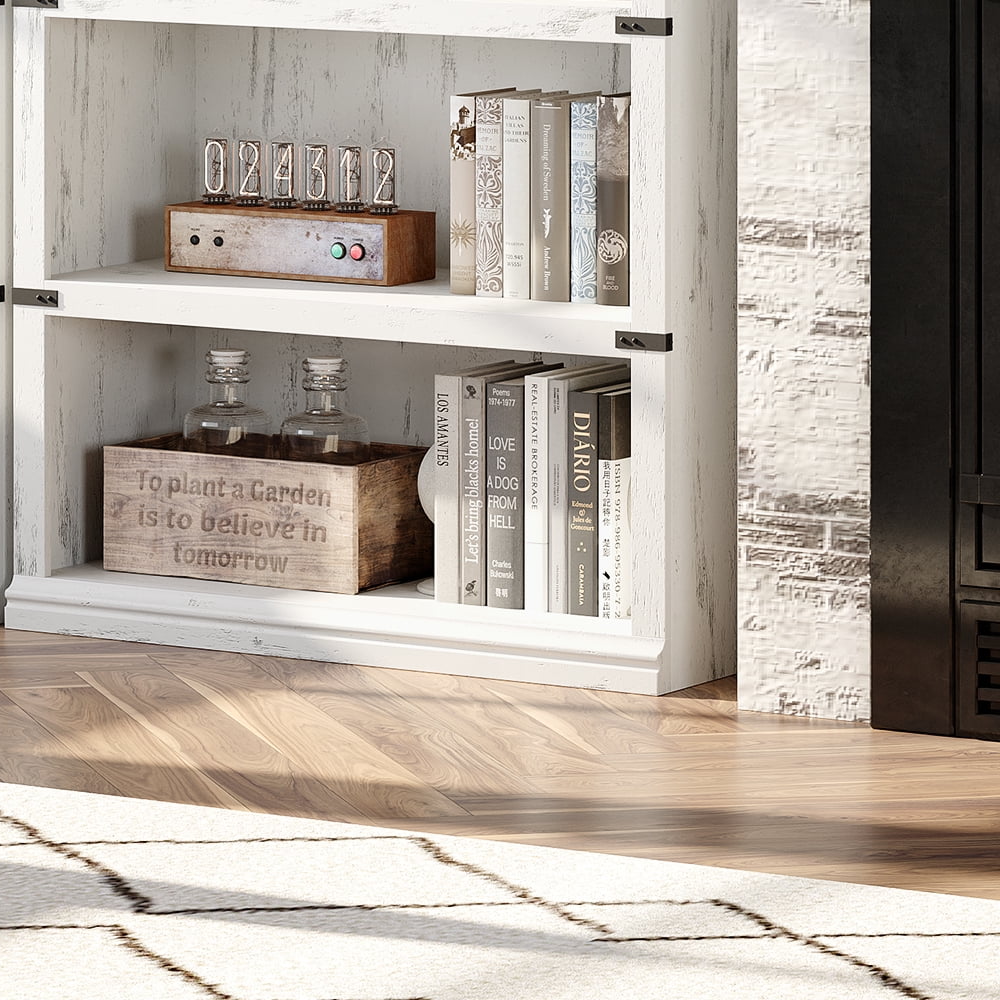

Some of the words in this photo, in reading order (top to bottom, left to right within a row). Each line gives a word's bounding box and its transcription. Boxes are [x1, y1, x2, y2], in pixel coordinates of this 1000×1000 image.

[542, 124, 551, 162] Dreaming
[543, 162, 552, 170] of
[543, 170, 552, 201] Sweden
[543, 245, 551, 270] Andrew
[437, 393, 448, 412] LOS
[488, 397, 516, 406] 1974-1977
[492, 387, 510, 396] Poems
[437, 416, 448, 466] AMANTES
[464, 418, 479, 458] home!
[488, 436, 516, 452] LOVE
[496, 456, 506, 470] IS
[574, 412, 596, 492] DIÁRIO
[136, 469, 162, 492] To
[168, 471, 226, 499] plant
[232, 482, 244, 499] a
[250, 479, 332, 507] Garden
[464, 459, 479, 498] blacks
[486, 475, 494, 488] A
[494, 476, 518, 490] DOG
[488, 494, 517, 510] FROM
[572, 500, 594, 508] Edmond
[138, 504, 158, 527] is
[166, 508, 192, 530] to
[200, 510, 295, 540] believe
[303, 518, 327, 543] in
[465, 499, 483, 534] bring
[490, 514, 516, 530] HELL
[174, 541, 288, 573] tomorrow
[465, 535, 479, 564] Let's
